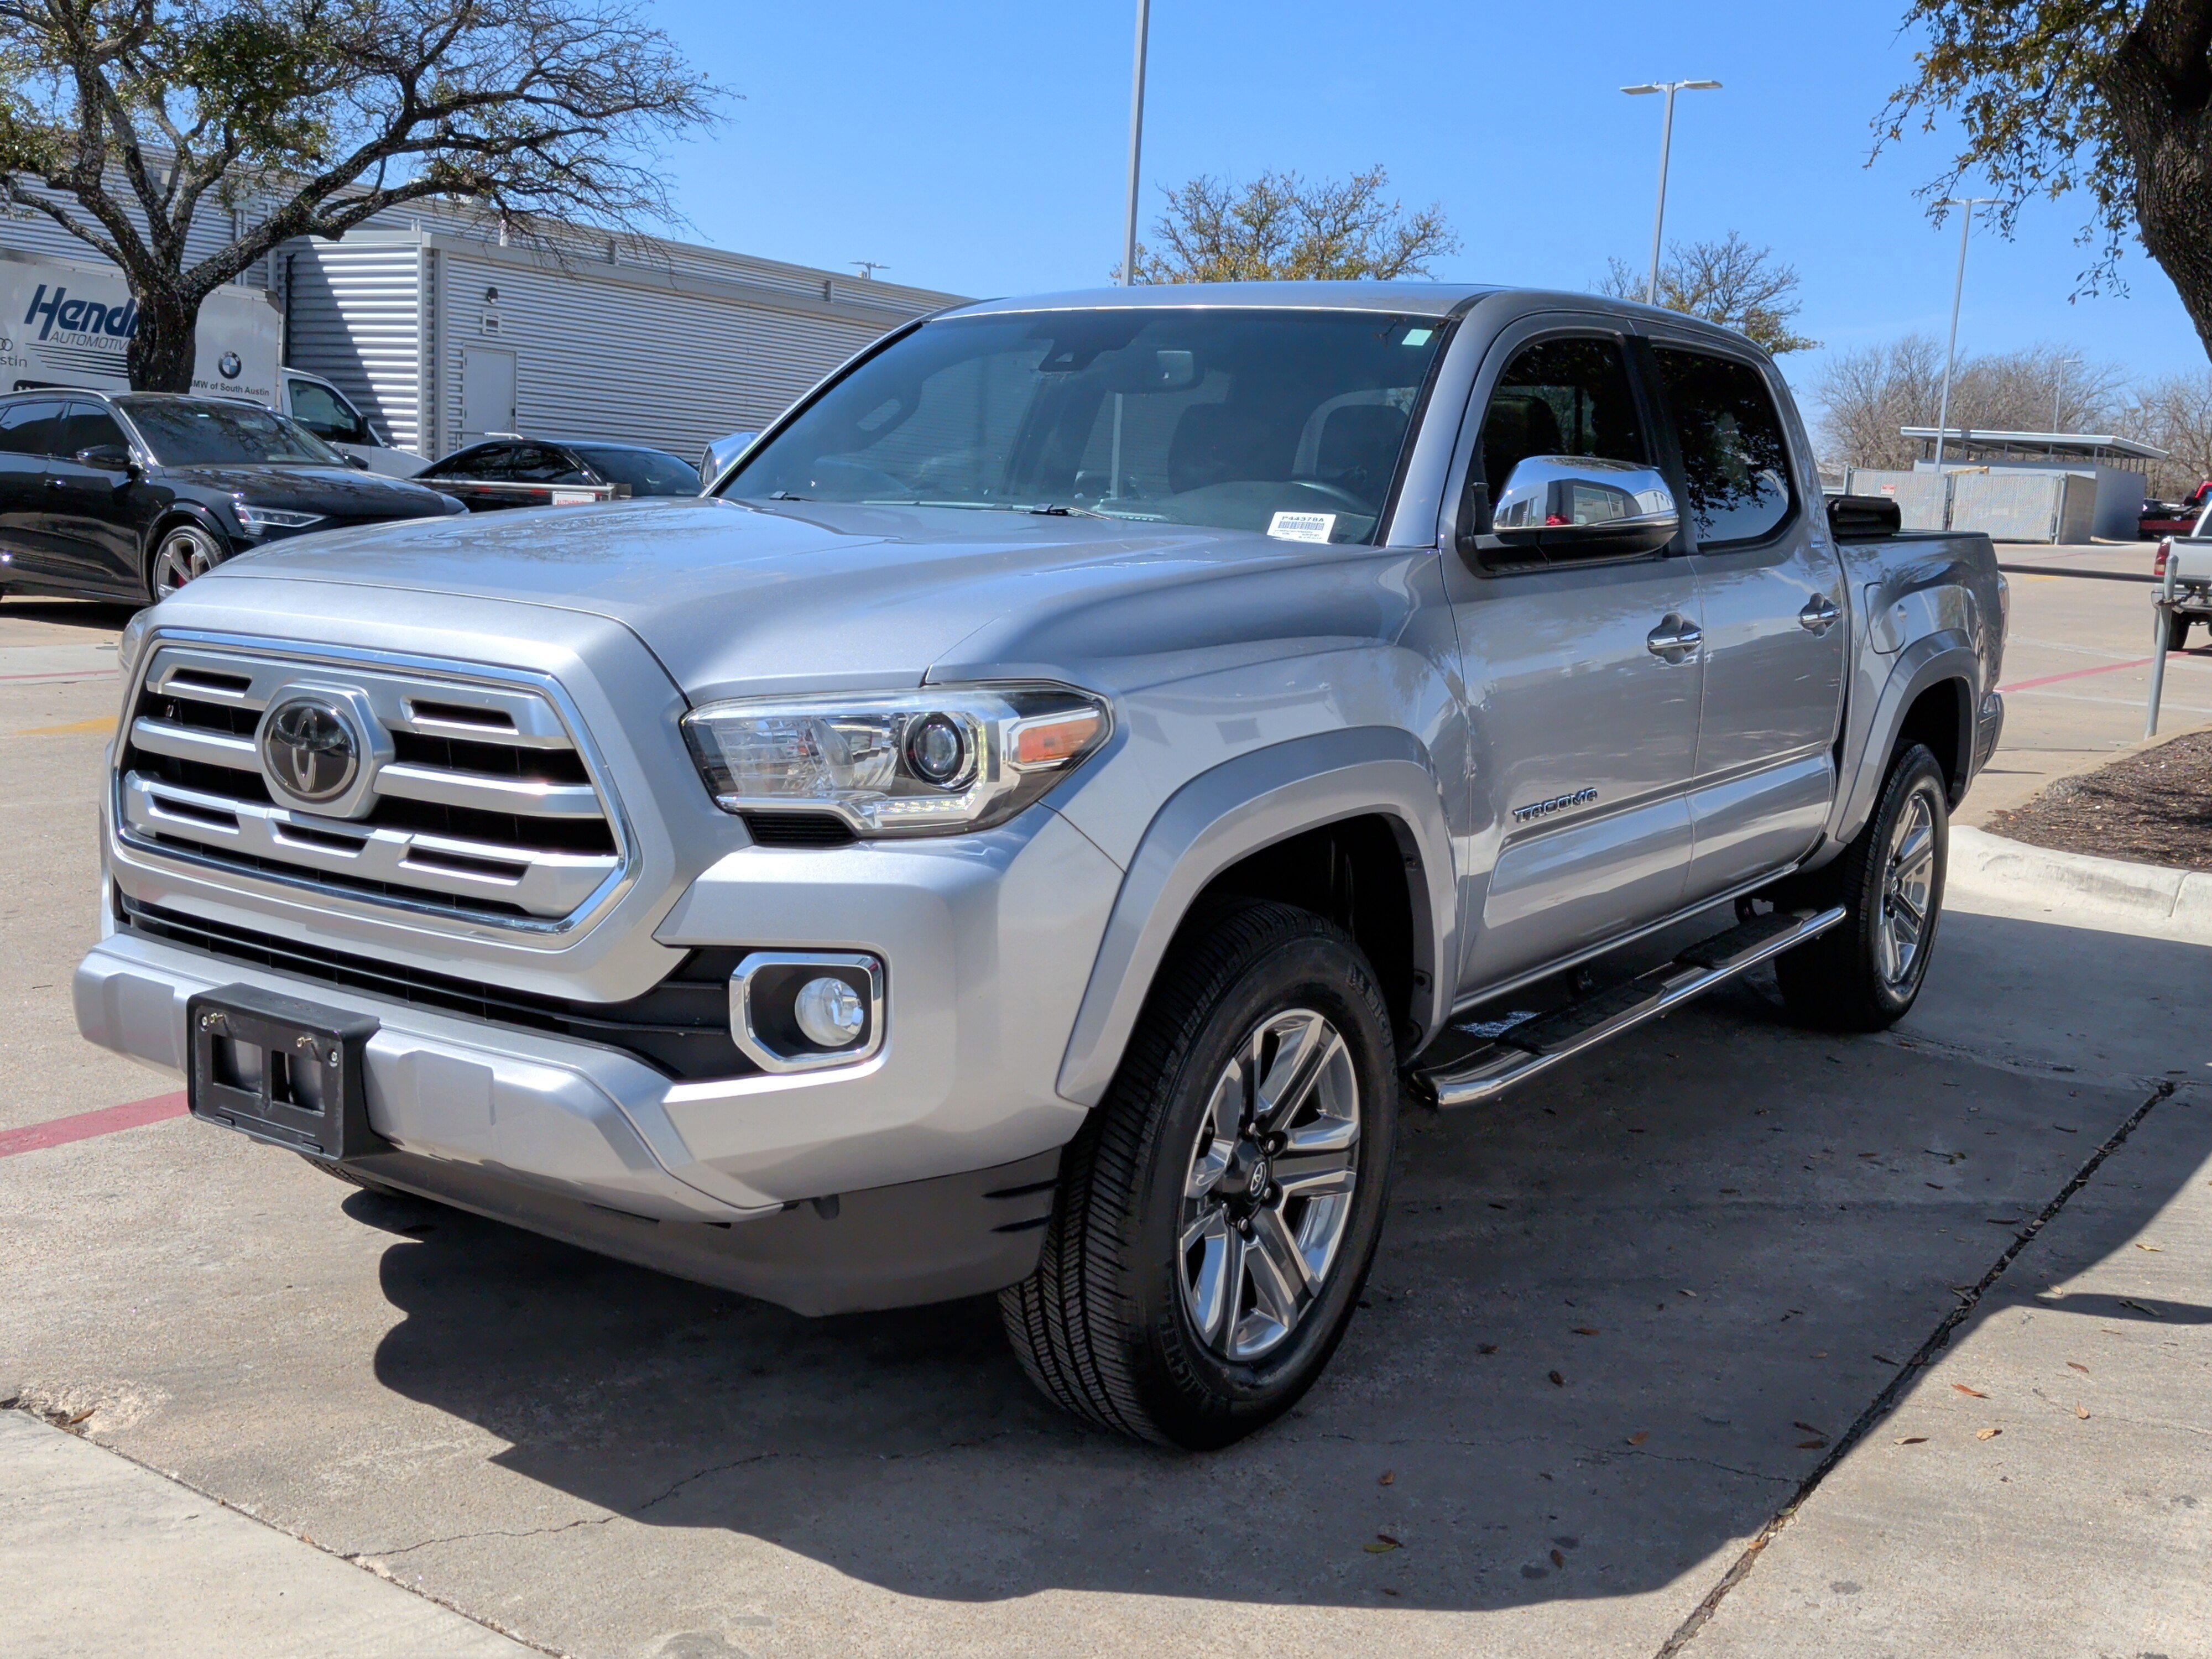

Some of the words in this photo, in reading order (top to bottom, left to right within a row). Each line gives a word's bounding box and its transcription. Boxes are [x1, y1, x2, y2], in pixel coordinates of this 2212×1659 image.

[49, 331, 130, 352] AUTOMOTIV
[190, 379, 208, 389] MW
[220, 383, 243, 393] South
[244, 387, 269, 396] Austin
